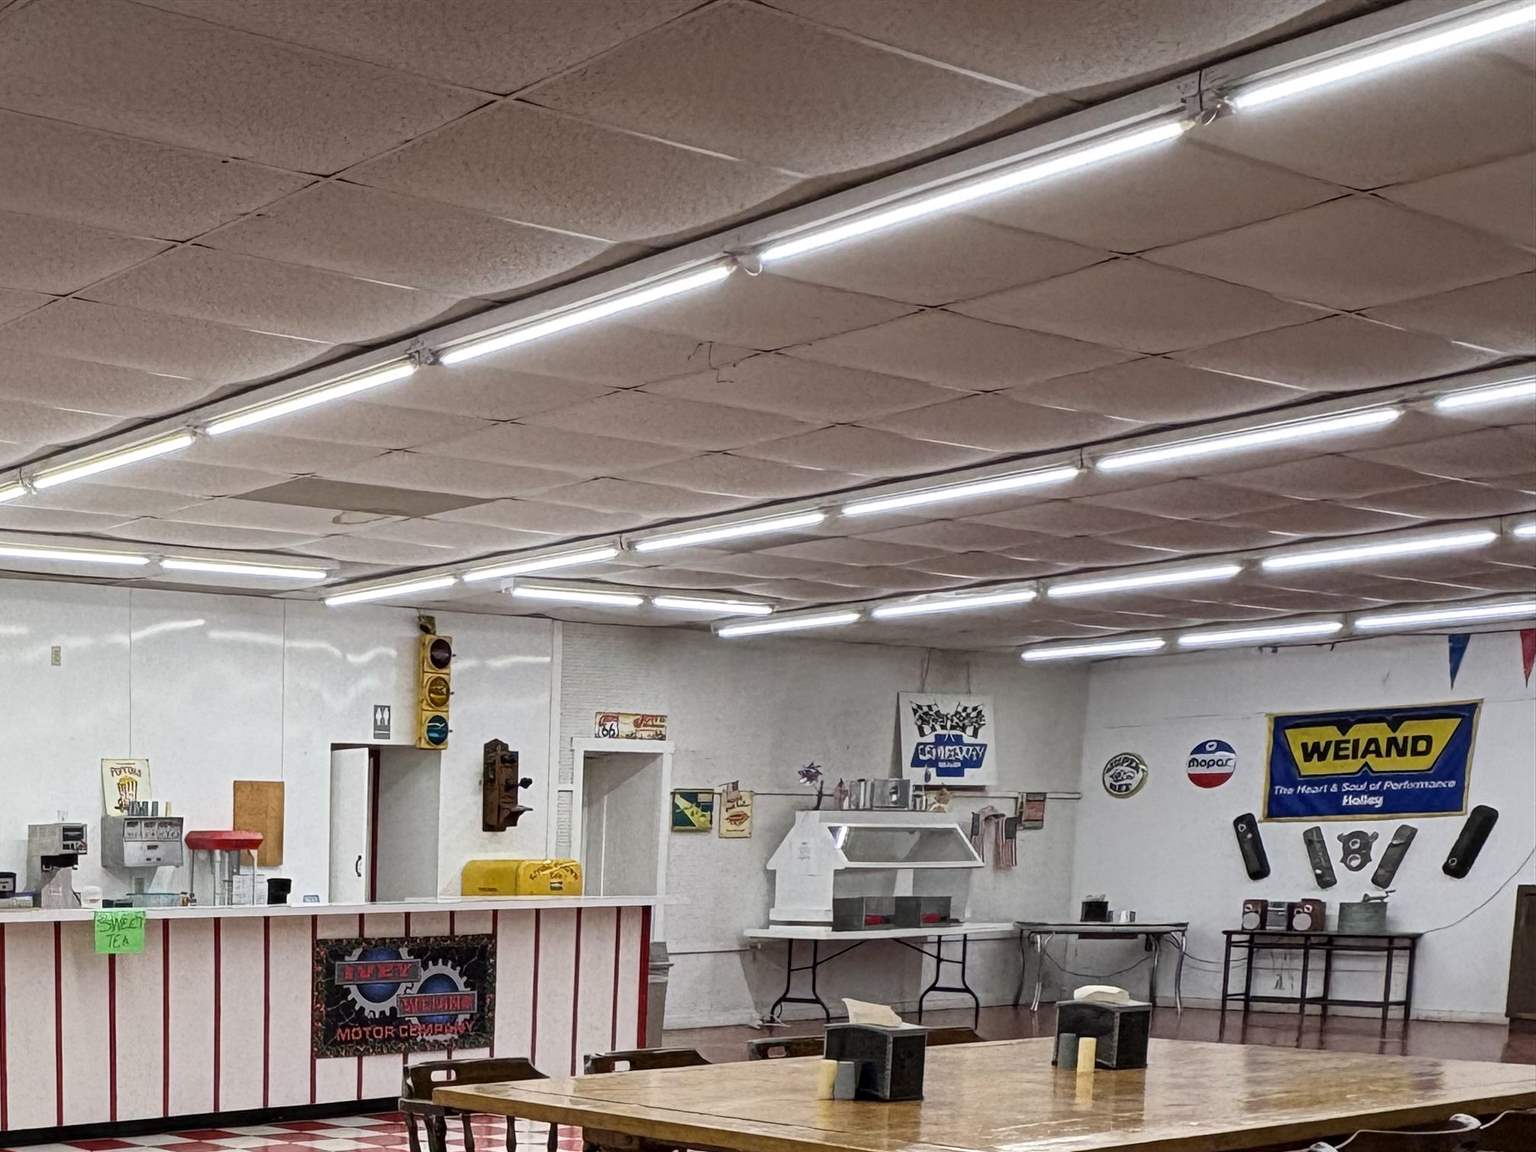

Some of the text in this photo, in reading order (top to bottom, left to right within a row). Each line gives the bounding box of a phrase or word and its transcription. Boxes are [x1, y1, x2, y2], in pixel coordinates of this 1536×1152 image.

[601, 723, 616, 738] 66
[1300, 734, 1434, 763] WEIAND
[1274, 779, 1457, 795] The Heart & Soul of Performance
[1341, 794, 1384, 808] Holley
[106, 934, 129, 948] TEA
[336, 1025, 395, 1042] MOTOR
